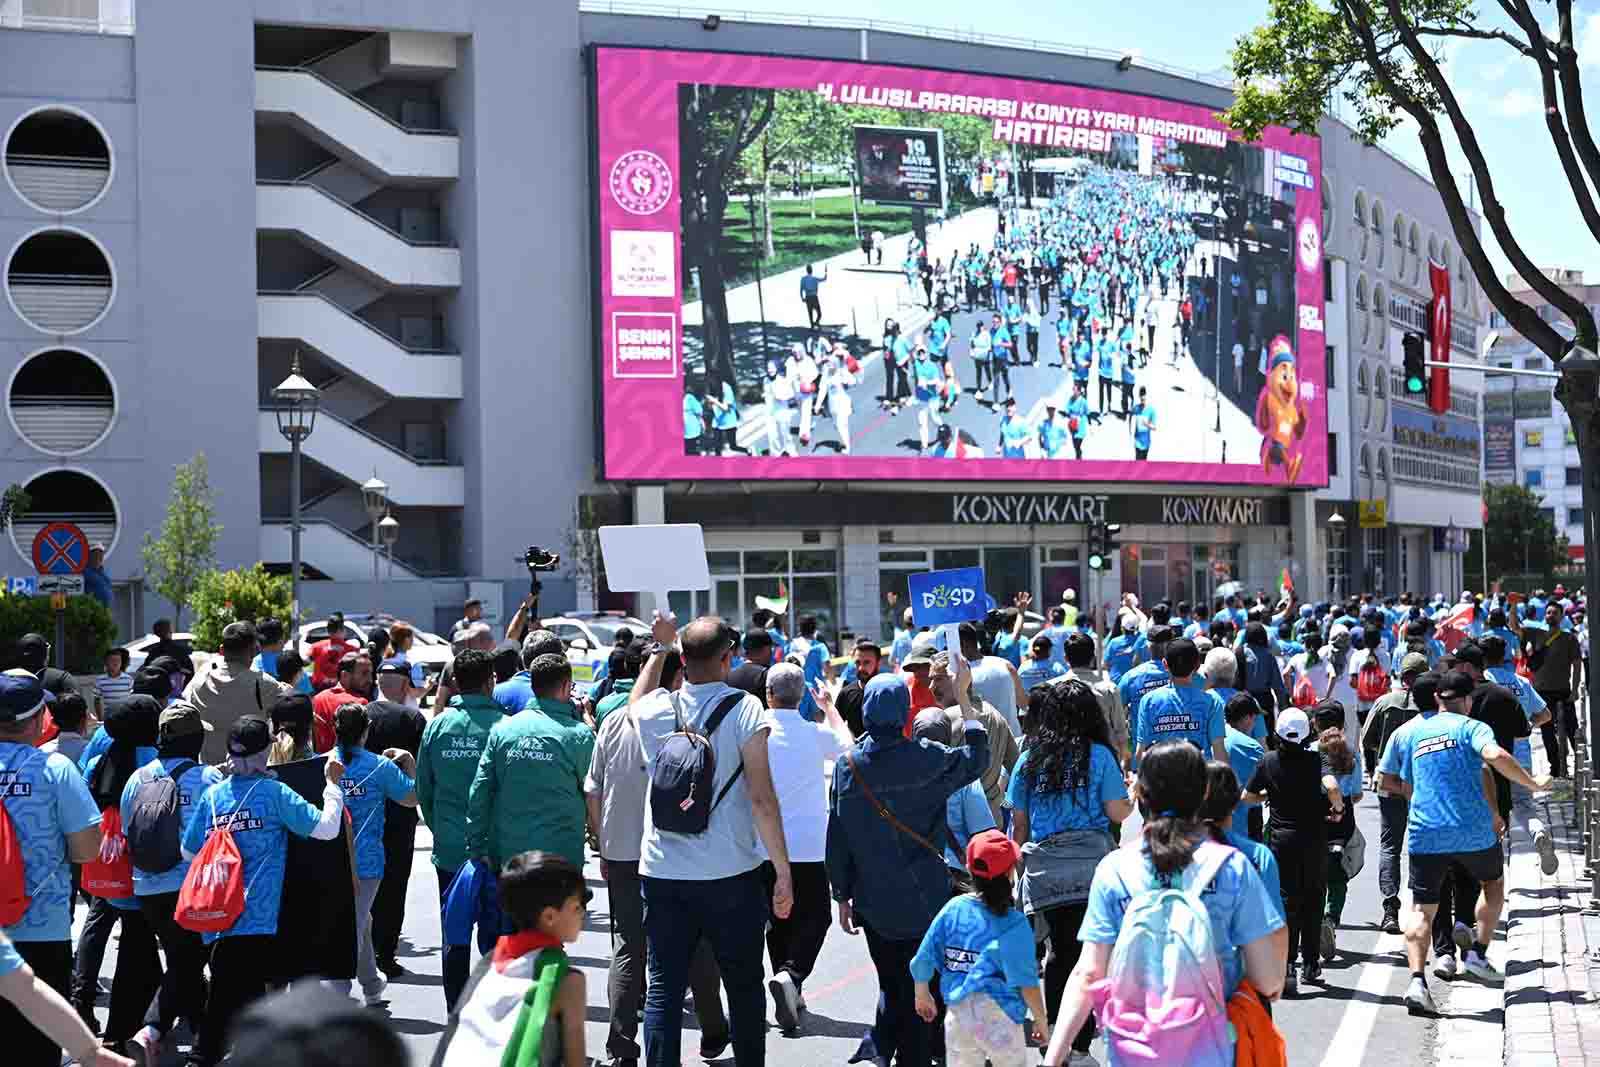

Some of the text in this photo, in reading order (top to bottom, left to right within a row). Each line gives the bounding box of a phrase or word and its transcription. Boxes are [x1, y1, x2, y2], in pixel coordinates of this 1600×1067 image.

[817, 83, 837, 102] 4.
[1020, 101, 1090, 127] KONYA
[1090, 110, 1135, 132] YARI
[1135, 117, 1227, 148] MARATONU
[904, 138, 926, 156] 19
[992, 118, 1113, 152] HATIRASI
[952, 495, 1262, 524] KONYAKART KONYAKART
